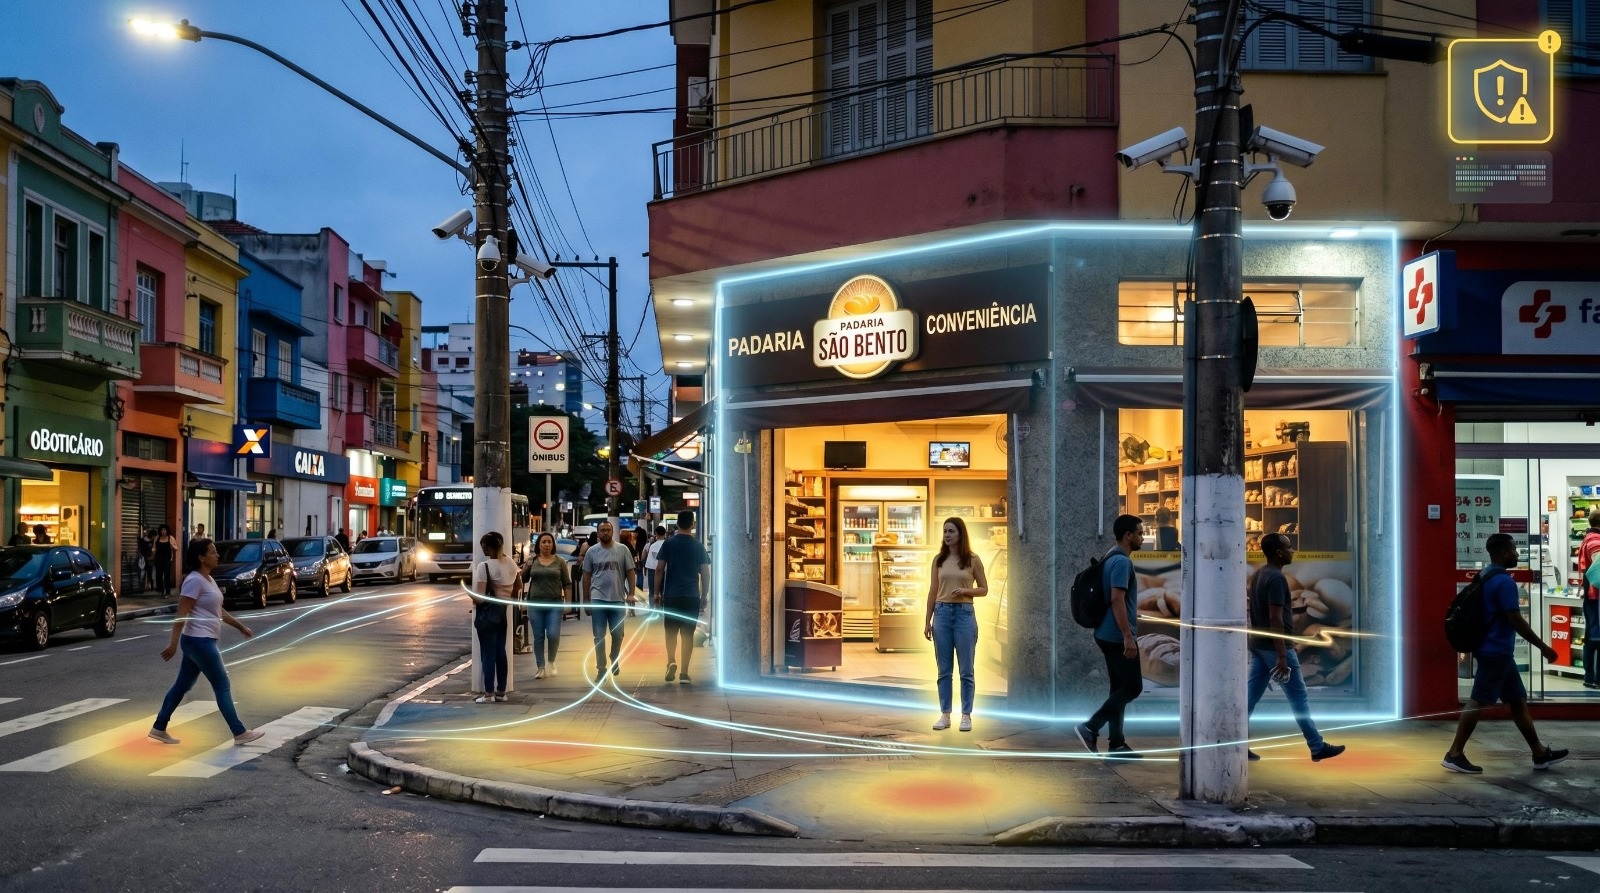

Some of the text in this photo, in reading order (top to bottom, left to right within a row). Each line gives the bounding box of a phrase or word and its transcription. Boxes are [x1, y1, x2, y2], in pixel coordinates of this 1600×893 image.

[840, 318, 884, 331] PADARIA
[926, 301, 1037, 335] CONVENIÊNCIA
[728, 330, 805, 357] PADARIA
[818, 328, 907, 361] SÃO BENTO
[294, 450, 325, 477] CAIXA
[532, 452, 566, 461] ÔNIBUS
